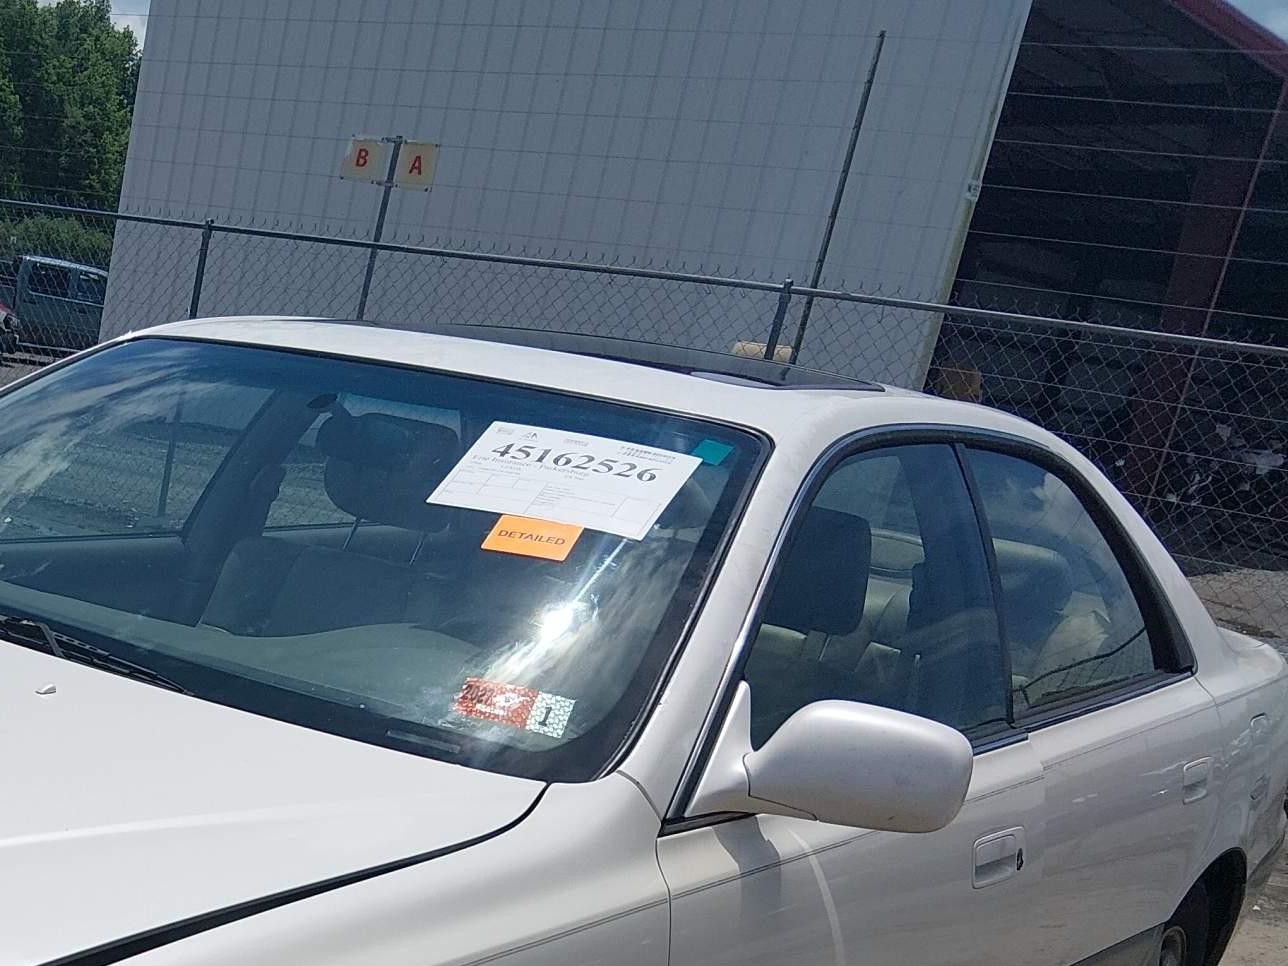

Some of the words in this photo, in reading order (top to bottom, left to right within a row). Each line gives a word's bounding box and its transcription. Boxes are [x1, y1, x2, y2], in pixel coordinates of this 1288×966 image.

[355, 148, 369, 168] B
[408, 155, 423, 176] A
[491, 442, 659, 482] 45162526
[497, 529, 566, 546] DETAILED
[538, 706, 553, 727] 1
